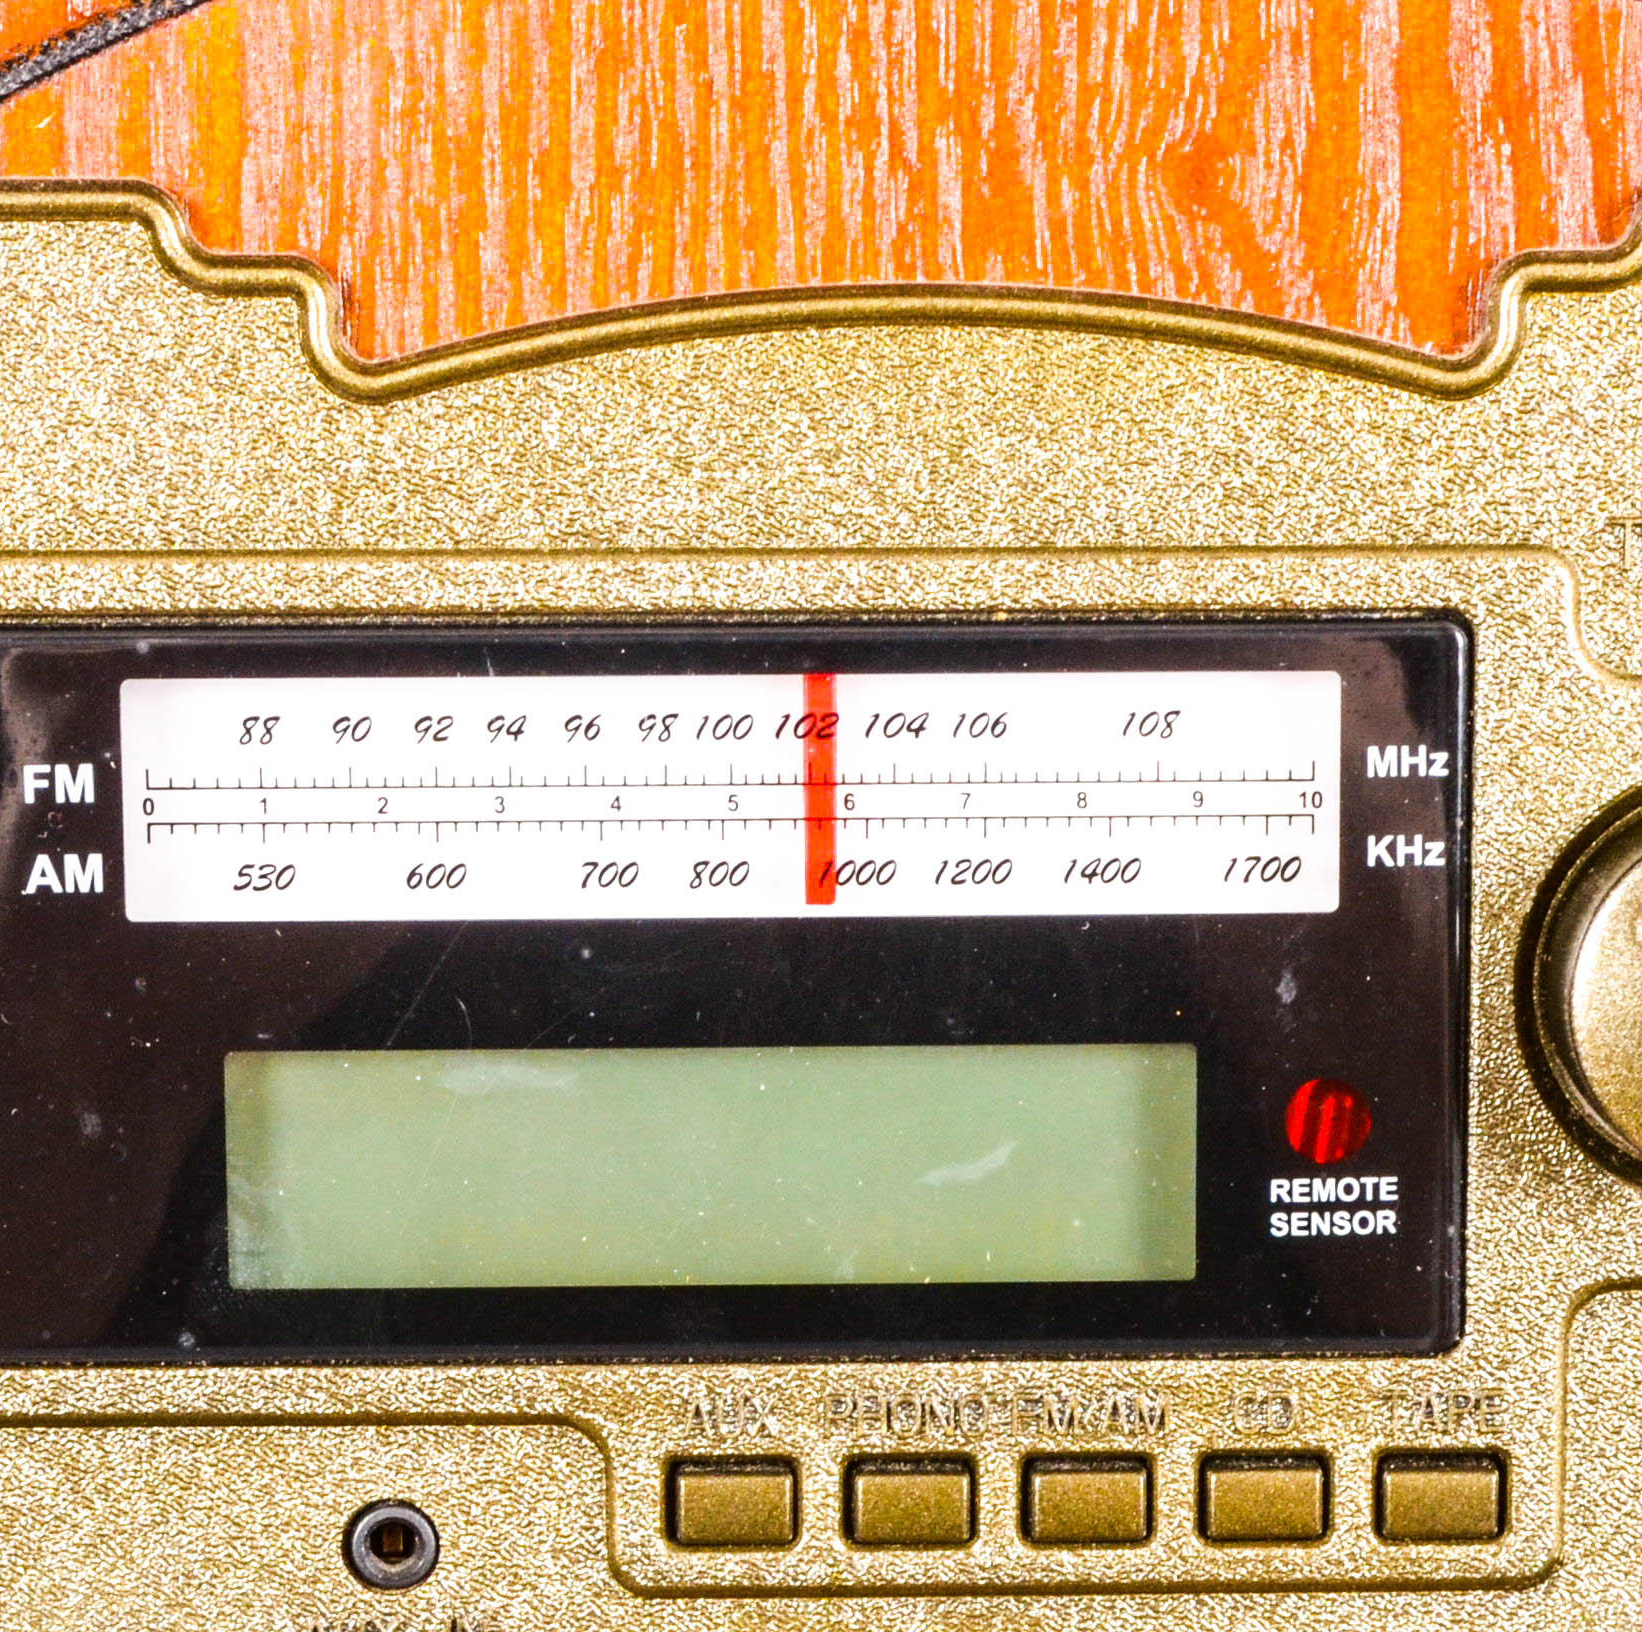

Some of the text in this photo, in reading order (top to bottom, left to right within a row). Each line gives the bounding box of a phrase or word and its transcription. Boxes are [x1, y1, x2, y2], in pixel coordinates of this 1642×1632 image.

[239, 710, 1181, 745] 88 90 92 94 96 98 100 102 104 106 108
[1366, 743, 1450, 778] MHz
[20, 762, 95, 804] FM
[142, 791, 1323, 816] 0 1 2 3 4 5 6 7 8 9 10
[1366, 833, 1446, 868] KHz
[21, 853, 104, 896] AM
[233, 856, 1302, 892] 530 600 700 800 1000 1200 1400 1700
[1269, 1176, 1399, 1203] REMOTE
[1269, 1209, 1397, 1238] SENSOR
[685, 1393, 780, 1438] AUX
[824, 1393, 988, 1437] PHONO
[1234, 1391, 1298, 1435] CD
[1382, 1390, 1508, 1433] TAPE
